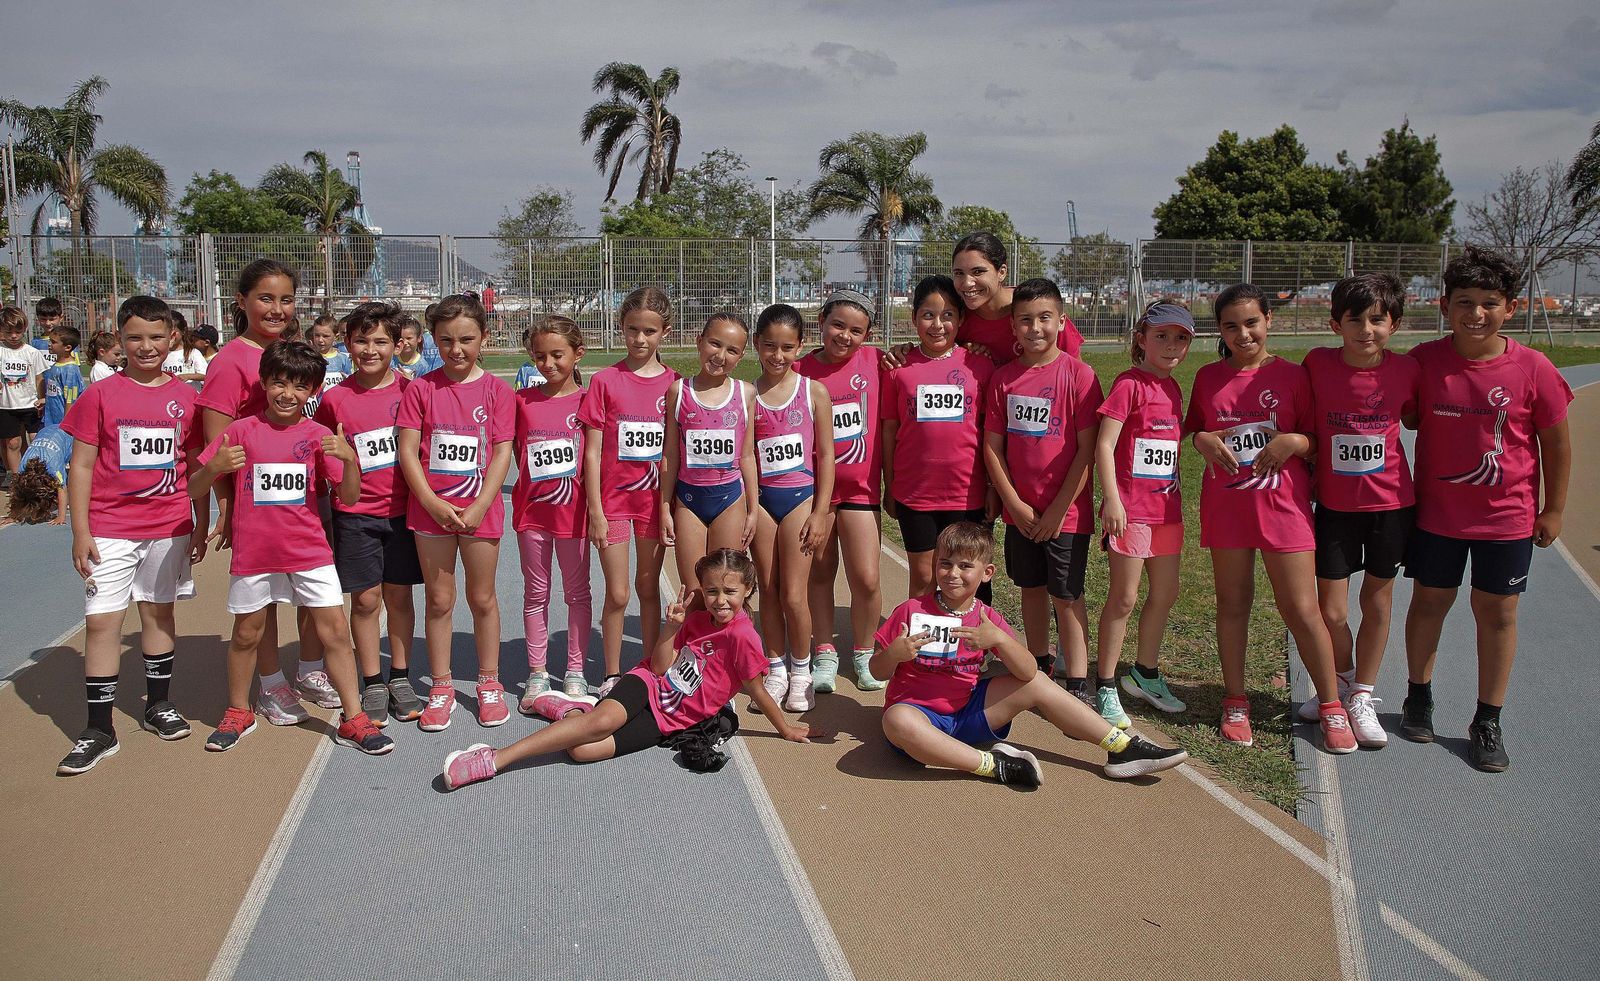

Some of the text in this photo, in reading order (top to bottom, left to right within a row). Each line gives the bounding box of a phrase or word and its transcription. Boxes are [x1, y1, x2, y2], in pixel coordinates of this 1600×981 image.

[6, 362, 26, 371] 3495
[924, 393, 962, 409] 3392
[116, 418, 172, 426] INMACULADA
[1015, 404, 1048, 423] 3412
[1328, 411, 1388, 422] ATLETISMO
[1328, 420, 1388, 430] INMACULADA
[131, 438, 173, 455] 3407
[625, 431, 662, 447] 3395
[693, 439, 733, 455] 3396
[438, 444, 476, 462] 3397
[534, 446, 573, 467] 3399
[765, 442, 803, 463] 3394
[1144, 448, 1176, 466] 3391
[1339, 444, 1383, 461] 3409
[261, 473, 304, 490] 3408
